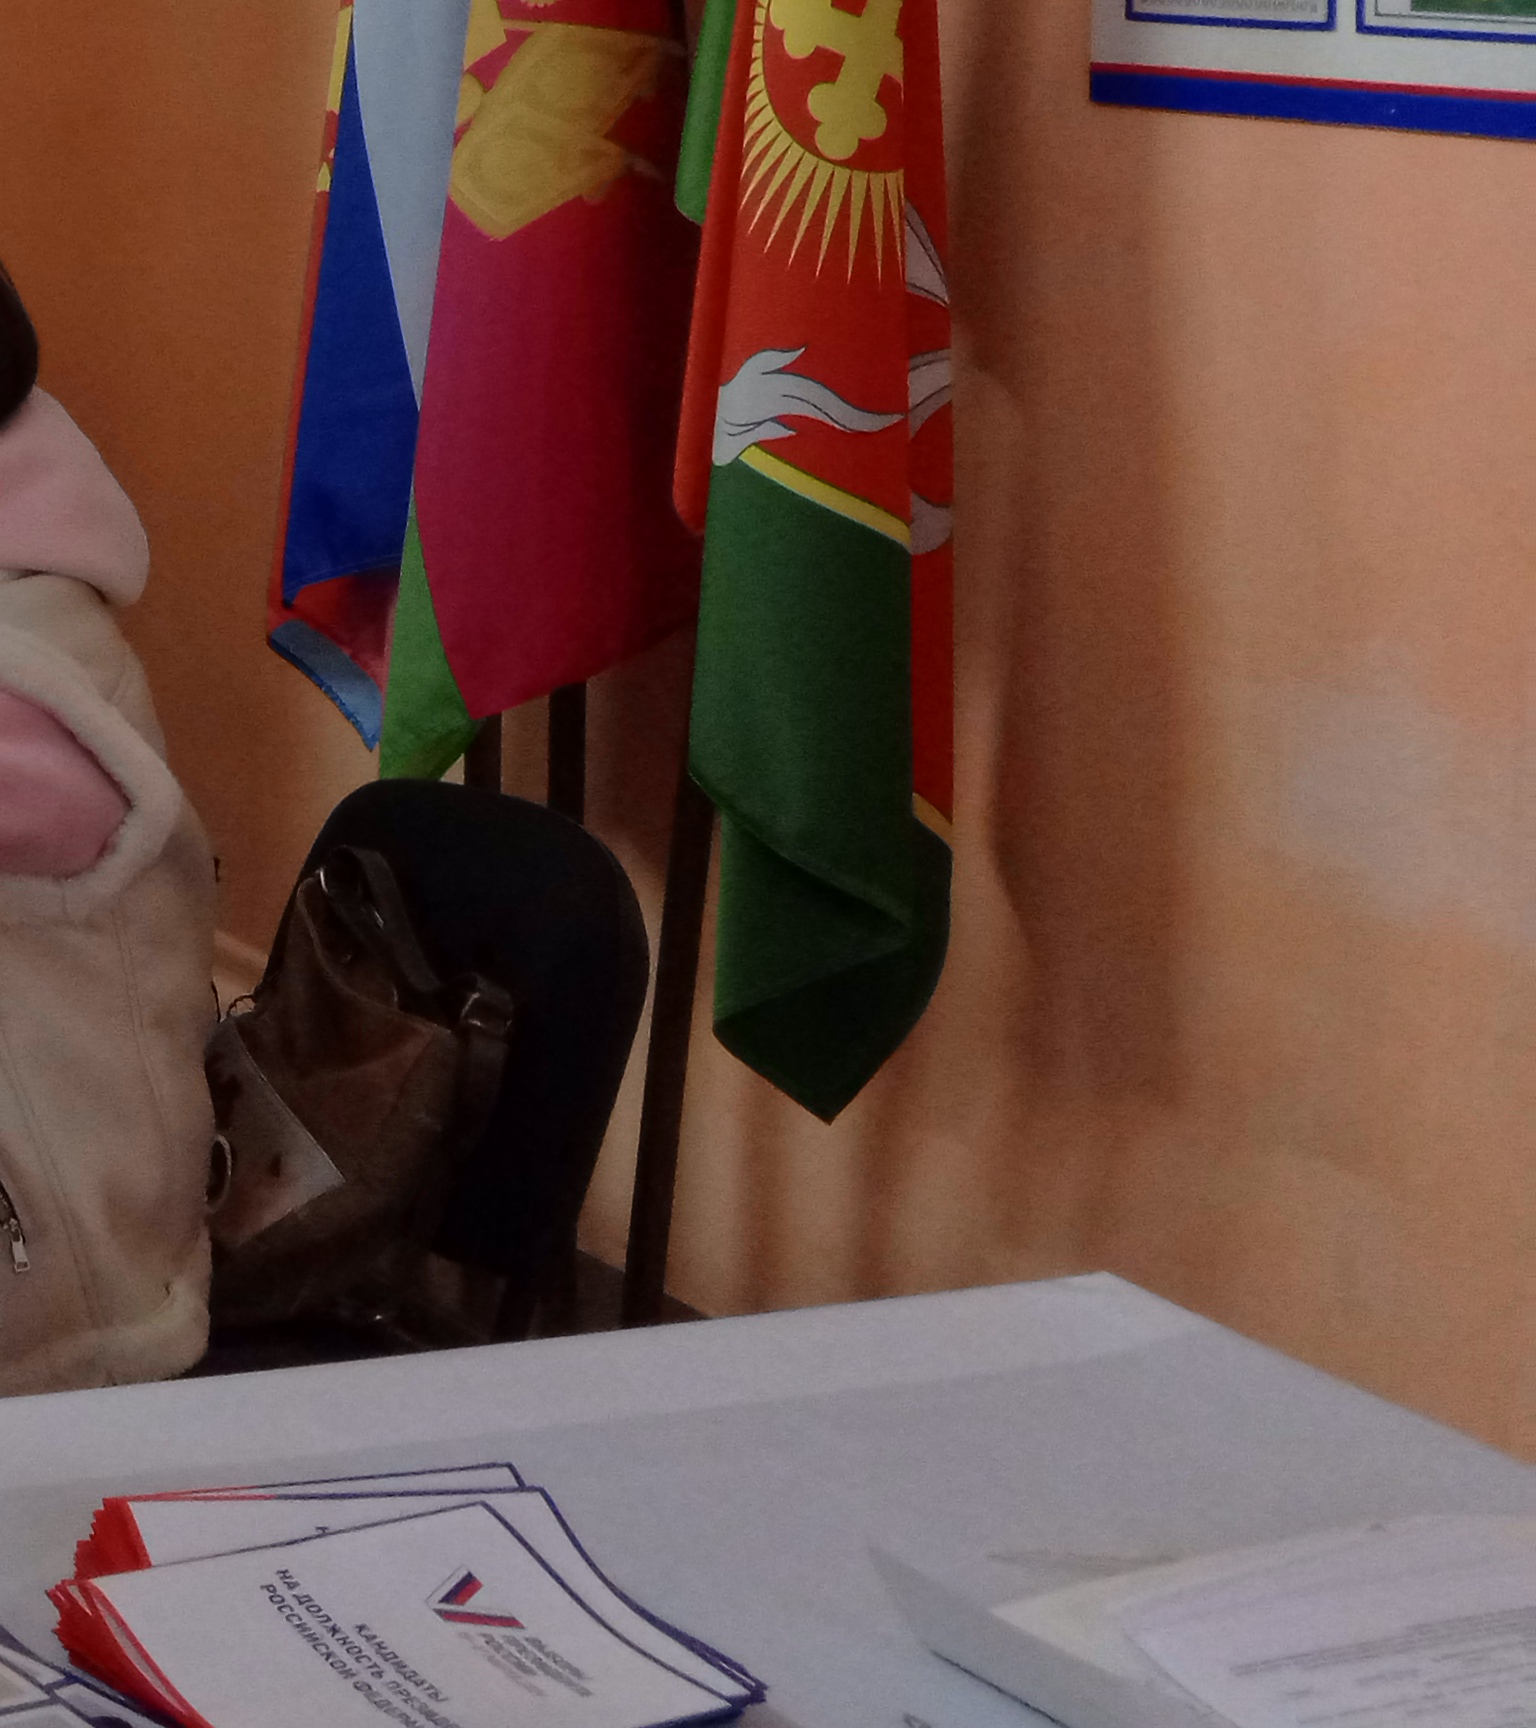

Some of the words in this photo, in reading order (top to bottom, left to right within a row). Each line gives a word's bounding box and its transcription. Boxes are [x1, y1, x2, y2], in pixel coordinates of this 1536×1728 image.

[260, 1583, 357, 1680] РОССИЙСКОЙ
[276, 1569, 301, 1591] НА
[292, 1593, 384, 1680] ДОЛЖНОСТЬ
[354, 1623, 449, 1703] КАНДИДАТЫ
